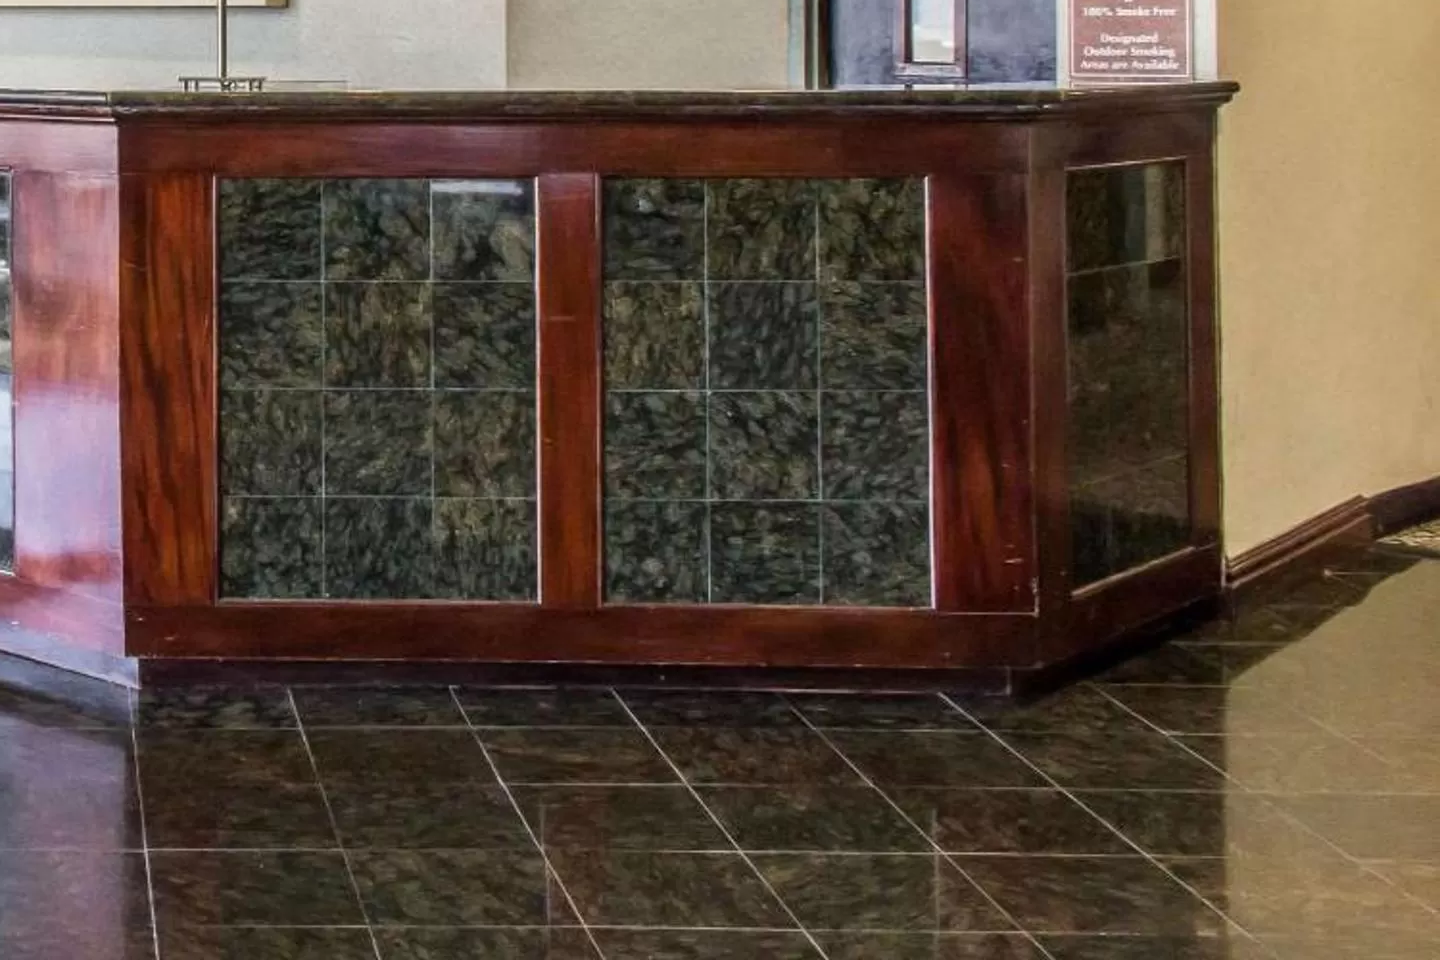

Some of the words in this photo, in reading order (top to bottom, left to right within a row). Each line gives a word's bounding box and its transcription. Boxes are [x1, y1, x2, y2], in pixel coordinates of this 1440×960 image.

[1100, 33, 1159, 45] Designated
[1083, 47, 1128, 57] Outdoor
[1130, 46, 1176, 58] Smoking
[1131, 59, 1180, 70] Available
